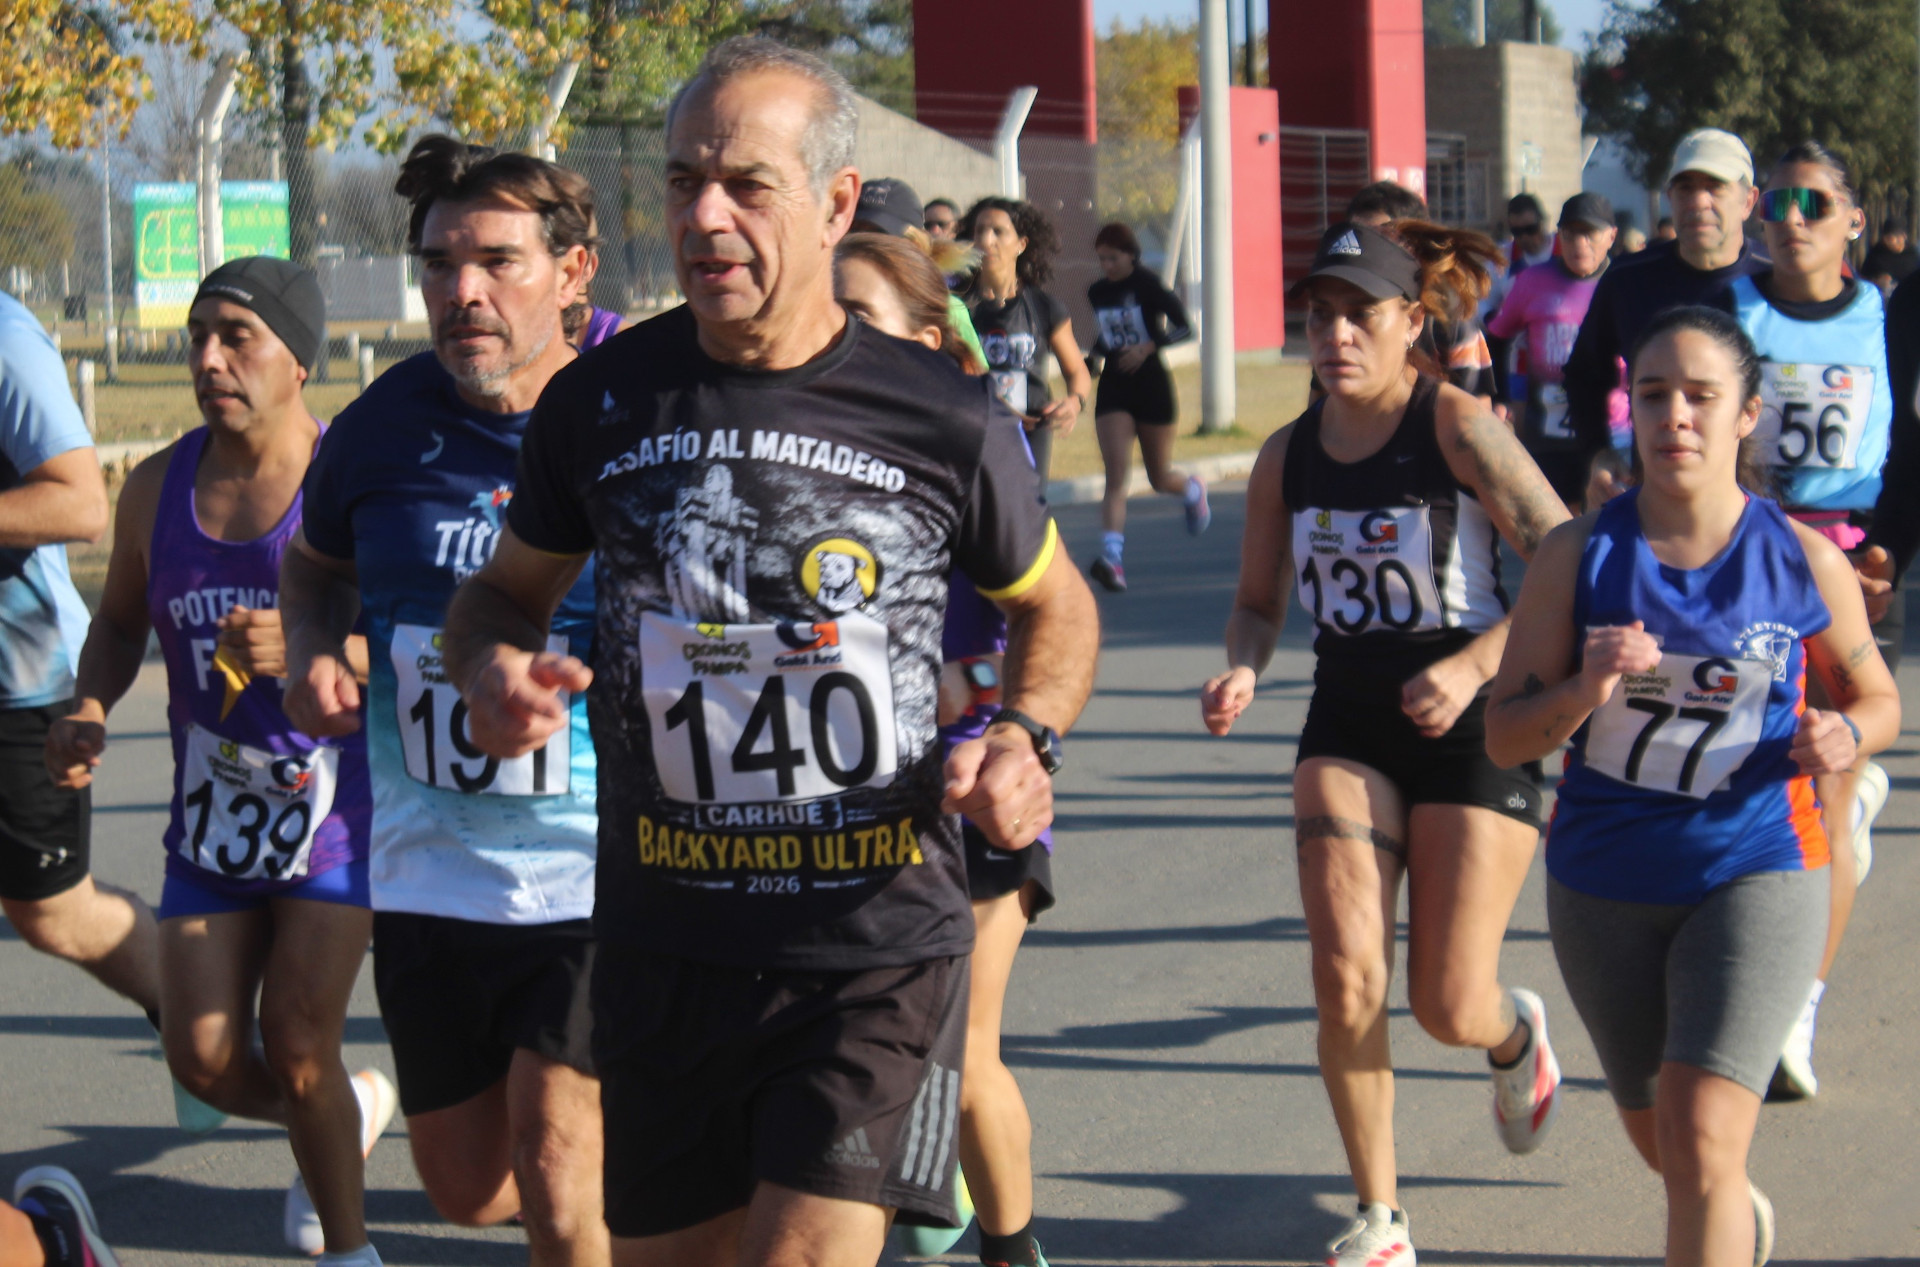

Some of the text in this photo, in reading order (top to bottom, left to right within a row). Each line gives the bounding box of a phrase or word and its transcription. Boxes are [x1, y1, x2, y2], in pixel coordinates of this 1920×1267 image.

[706, 429, 745, 459] AL
[751, 429, 906, 493] MATADERO
[1778, 402, 1851, 466] 56
[168, 587, 280, 630] POTENC
[1302, 556, 1423, 634] 130
[664, 671, 880, 801] 140
[1625, 697, 1730, 793] 77
[186, 780, 311, 878] 139
[638, 815, 924, 871] BACKYARD ULTRA
[746, 876, 800, 894] 2026
[824, 1150, 880, 1169] adidas
